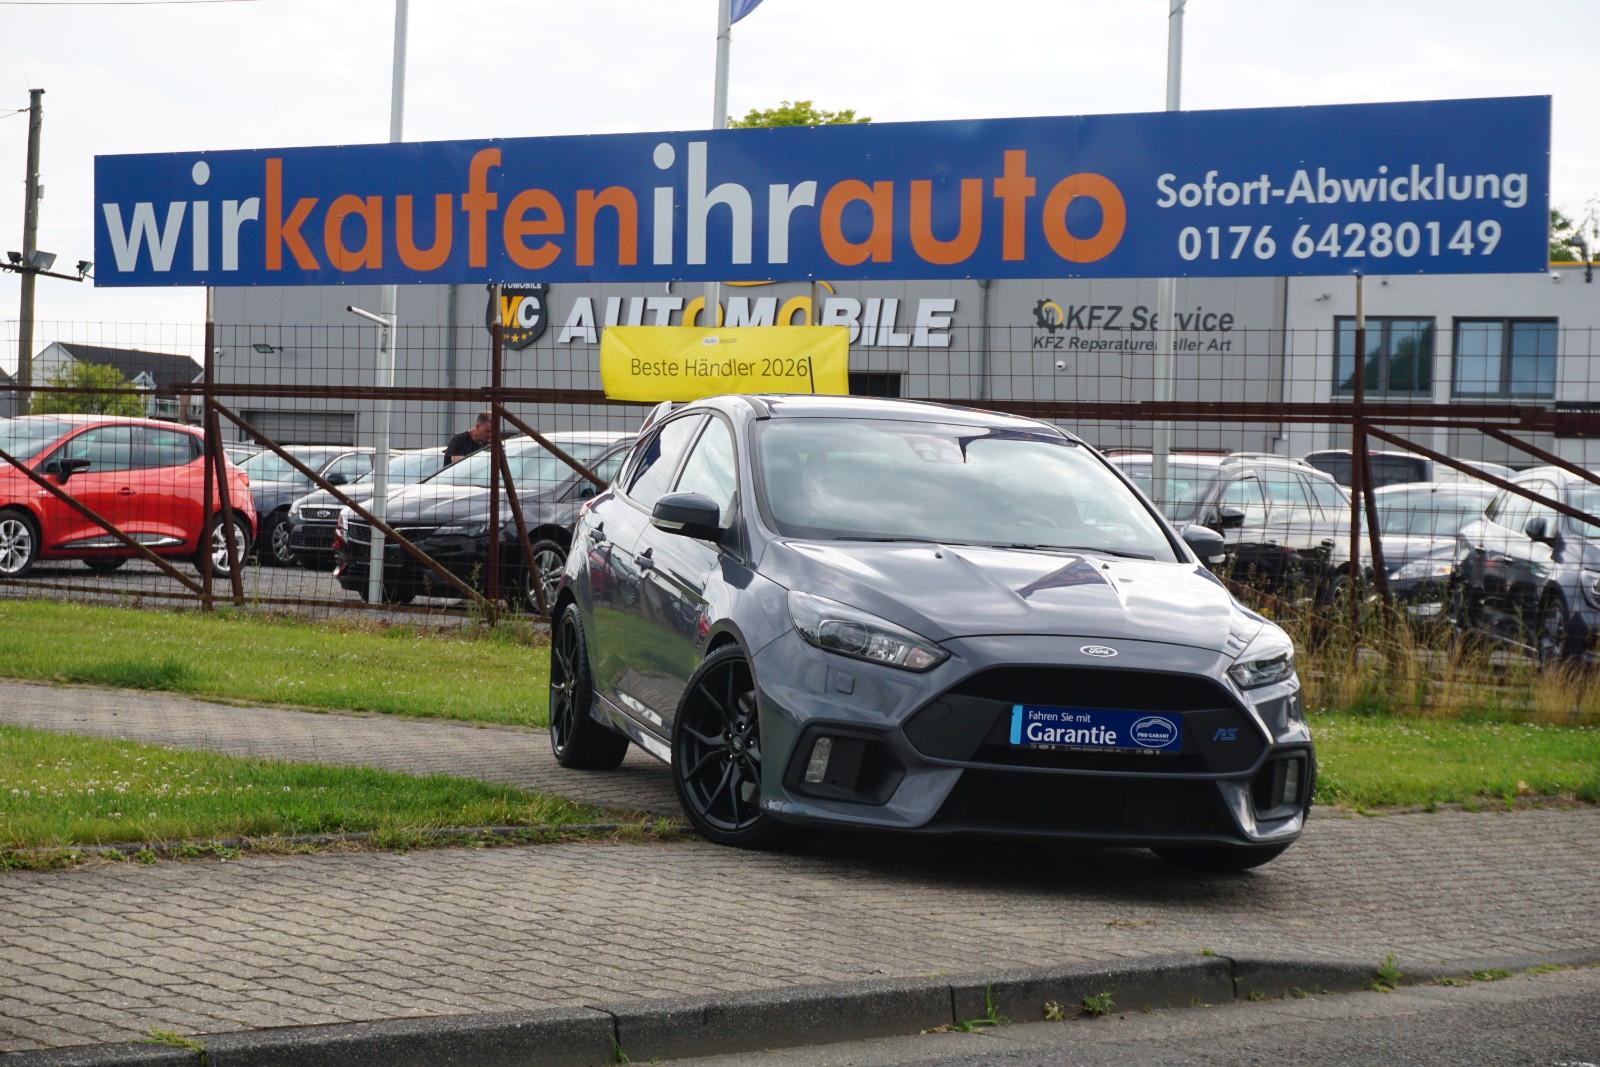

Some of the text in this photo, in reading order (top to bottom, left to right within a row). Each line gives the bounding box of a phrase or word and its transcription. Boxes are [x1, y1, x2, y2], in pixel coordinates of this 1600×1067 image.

[1156, 163, 1528, 209] Sofort-Abwicklung
[102, 141, 1127, 273] wirkaufenihrauto
[1178, 219, 1502, 261] 0176 64280149
[1066, 305, 1235, 332] KFZ Sevice
[1033, 336, 1064, 350] KFZ
[1069, 336, 1158, 352] Reparature
[1207, 338, 1232, 351] Art
[631, 358, 808, 377] Beste Händler 2026
[1028, 710, 1091, 723] Fahren Sie mit
[1027, 722, 1117, 745] Garantie
